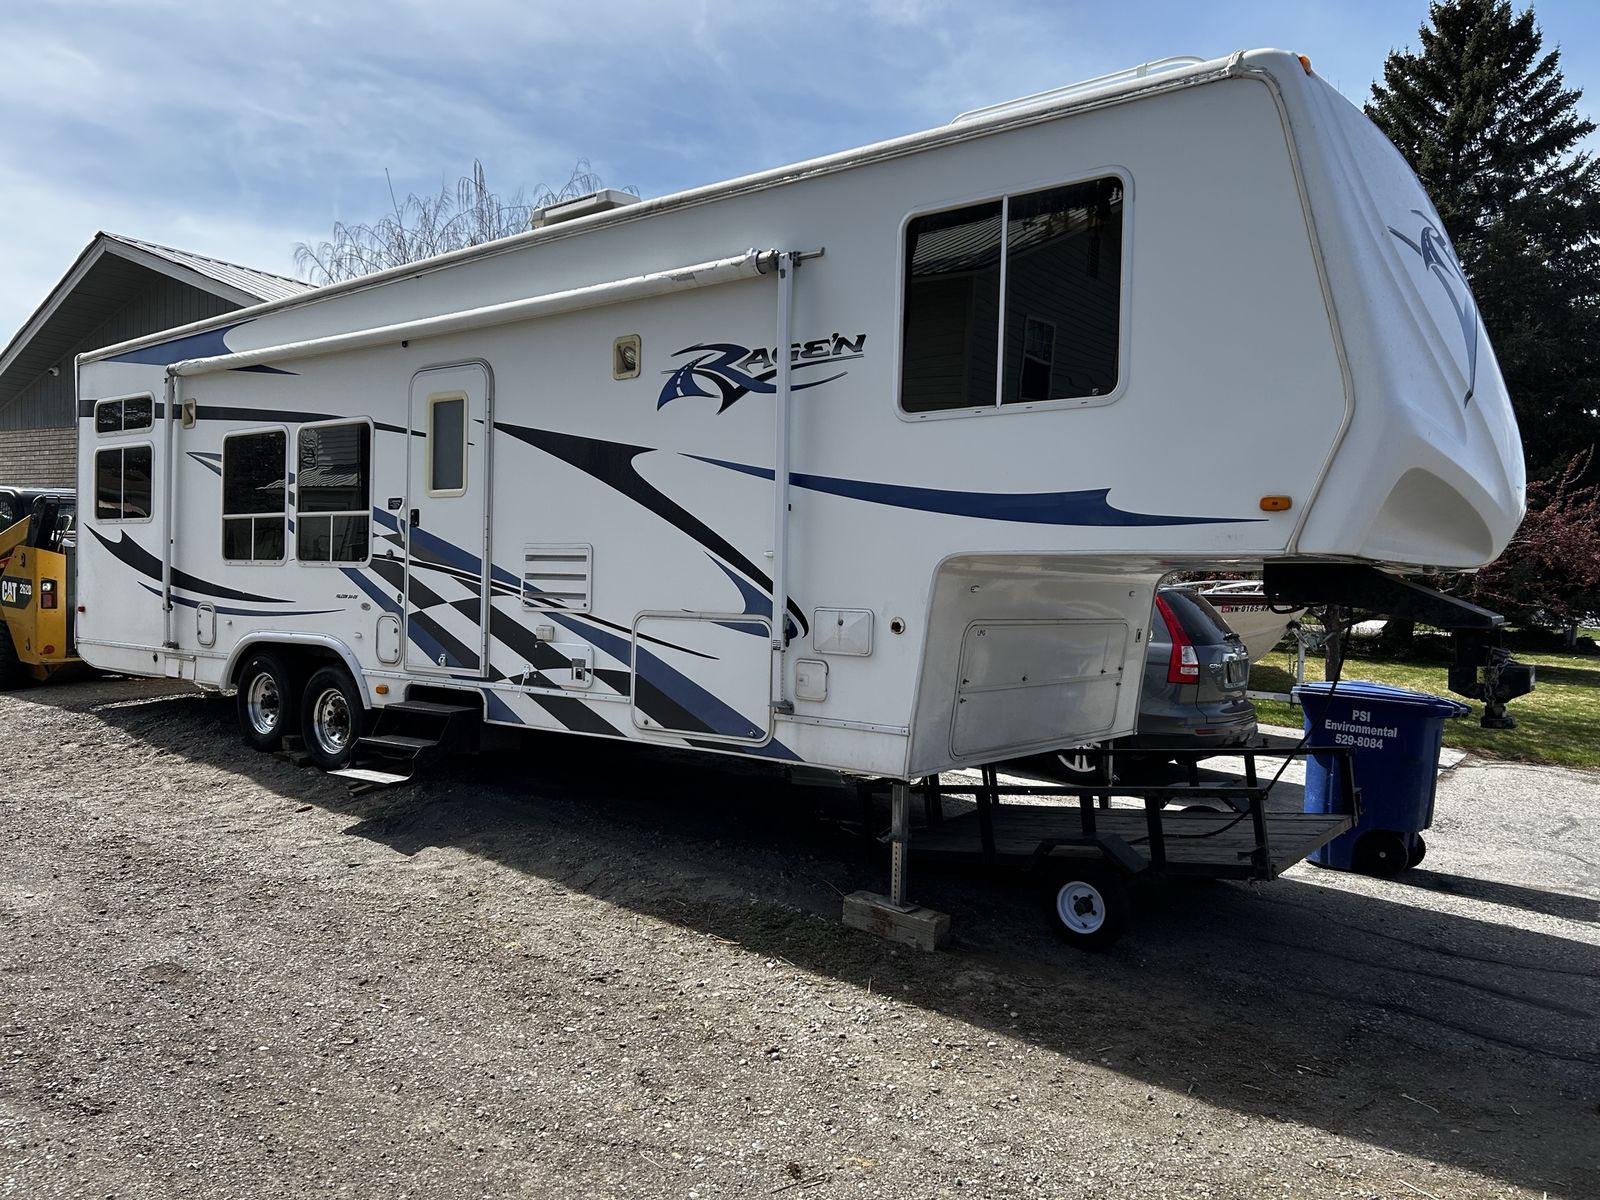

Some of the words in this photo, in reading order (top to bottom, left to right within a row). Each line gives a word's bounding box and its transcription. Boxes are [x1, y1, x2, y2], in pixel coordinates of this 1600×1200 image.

[2, 581, 17, 603] CAT
[1352, 709, 1371, 722] PSI
[1325, 718, 1398, 738] Environmental
[1335, 733, 1384, 750] 529-8084
